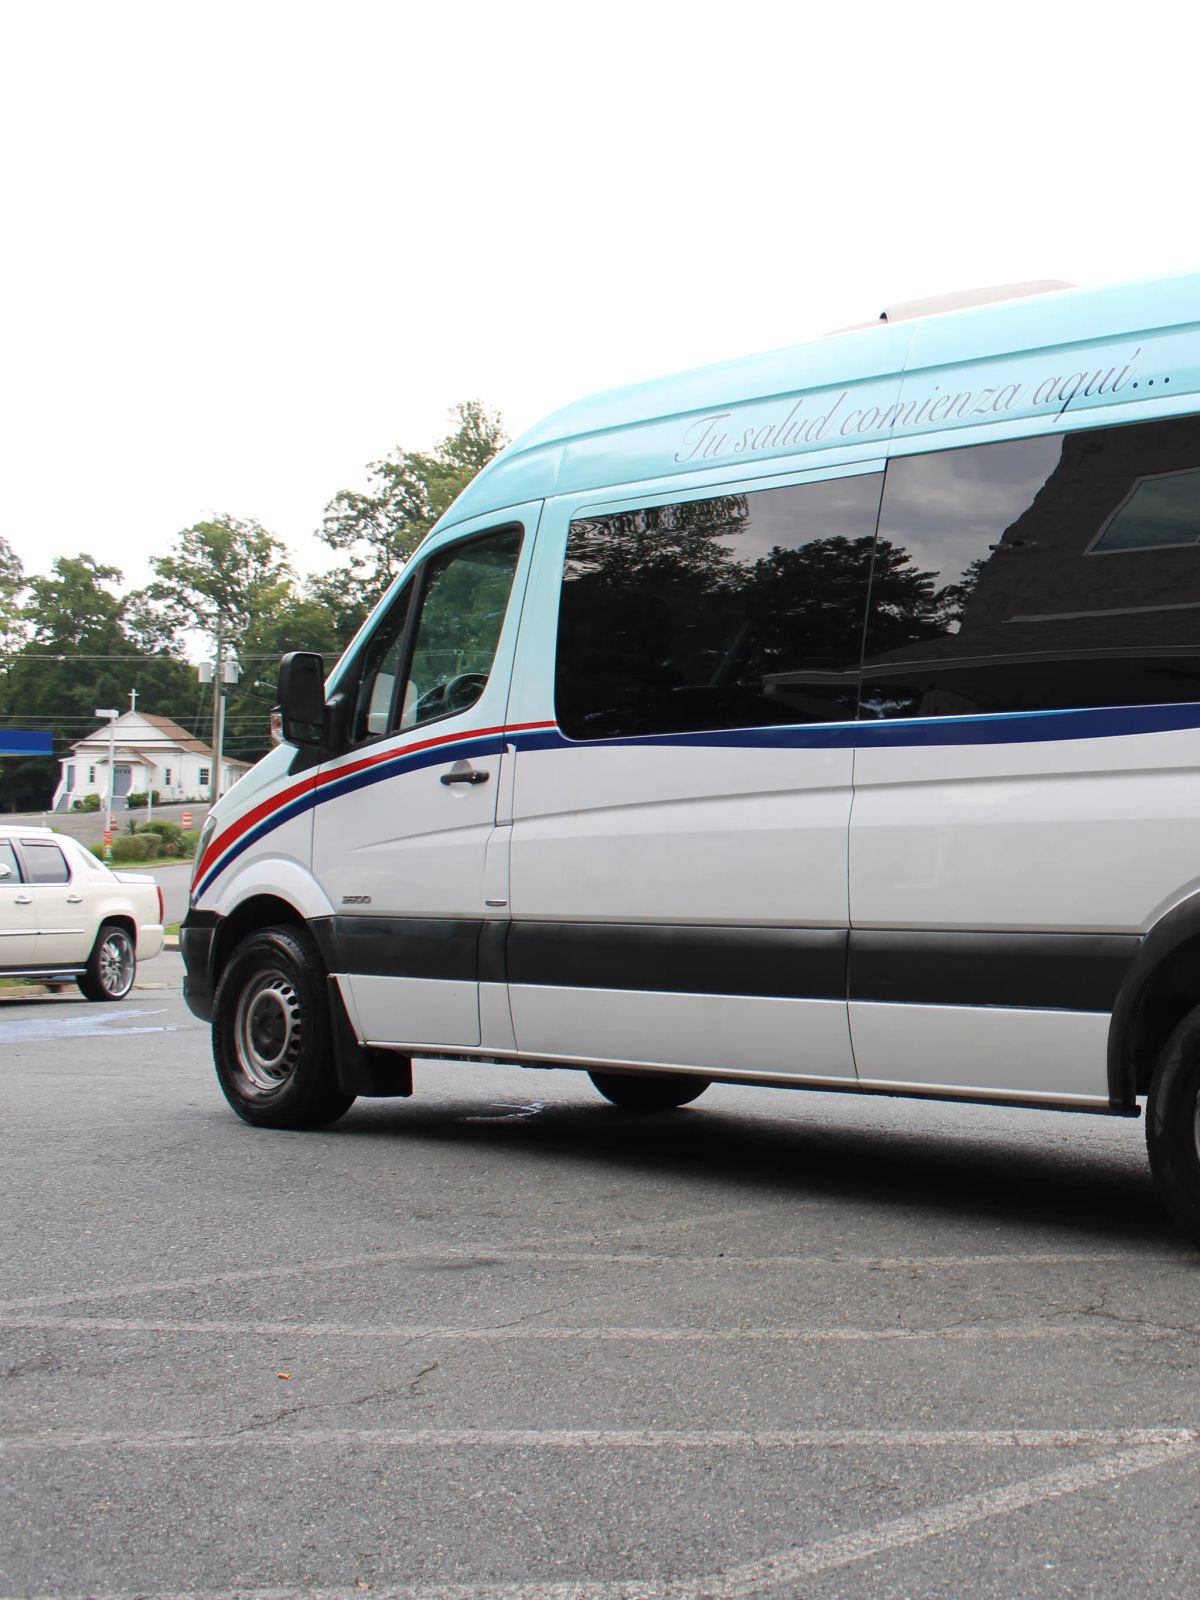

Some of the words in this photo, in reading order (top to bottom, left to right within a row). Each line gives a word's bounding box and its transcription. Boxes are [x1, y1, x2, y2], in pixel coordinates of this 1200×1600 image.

[674, 413, 731, 463] Tu
[734, 391, 848, 453] salud
[840, 384, 1022, 436] comienza
